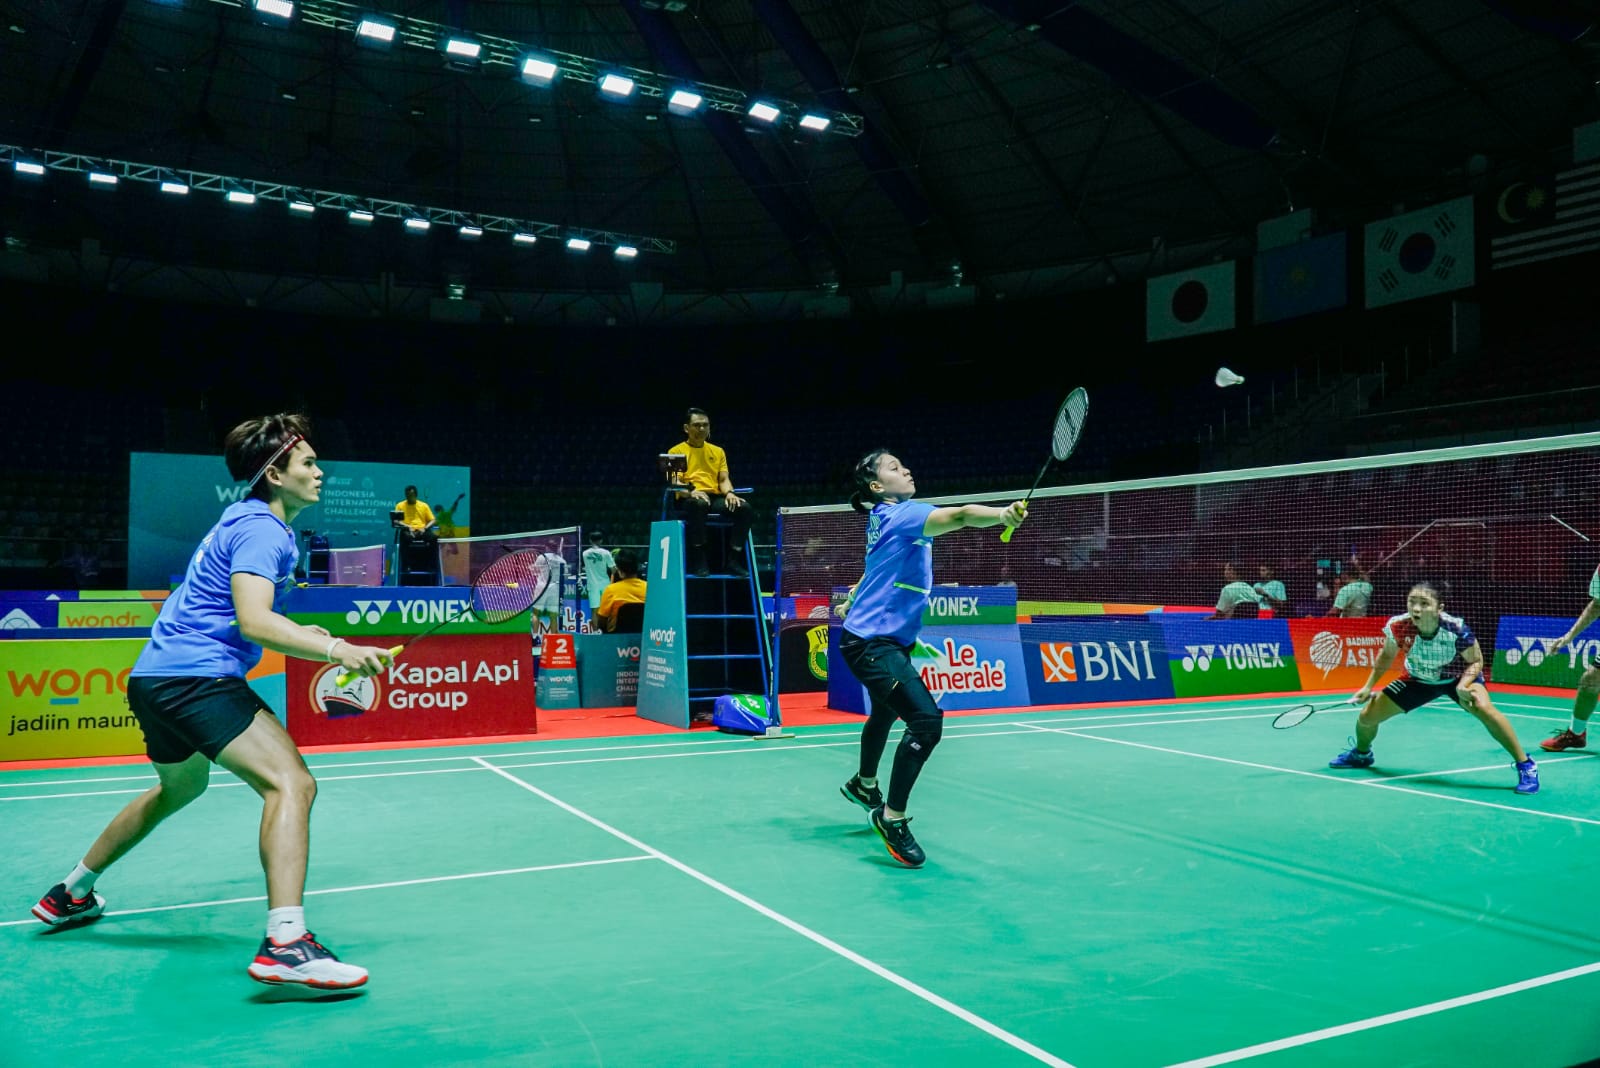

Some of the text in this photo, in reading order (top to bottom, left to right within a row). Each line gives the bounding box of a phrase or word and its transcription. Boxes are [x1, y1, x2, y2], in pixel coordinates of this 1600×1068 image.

[324, 490, 376, 498] INDONESIA
[324, 508, 377, 516] CHALLENGE
[660, 536, 670, 580] 1
[396, 600, 477, 624] YONEX
[928, 597, 980, 617] YONEX
[65, 612, 141, 628] wondr
[650, 627, 676, 643] wondr
[1346, 637, 1385, 647] BADMINTO
[555, 638, 568, 654] 2
[946, 641, 974, 668] Le
[1219, 642, 1285, 670] YONEX
[1079, 640, 1156, 681] BNI
[1346, 648, 1376, 667] ASI
[8, 668, 132, 697] won
[388, 660, 519, 687] Kapal Api
[388, 689, 468, 710] Group
[8, 714, 70, 736] jadiin
